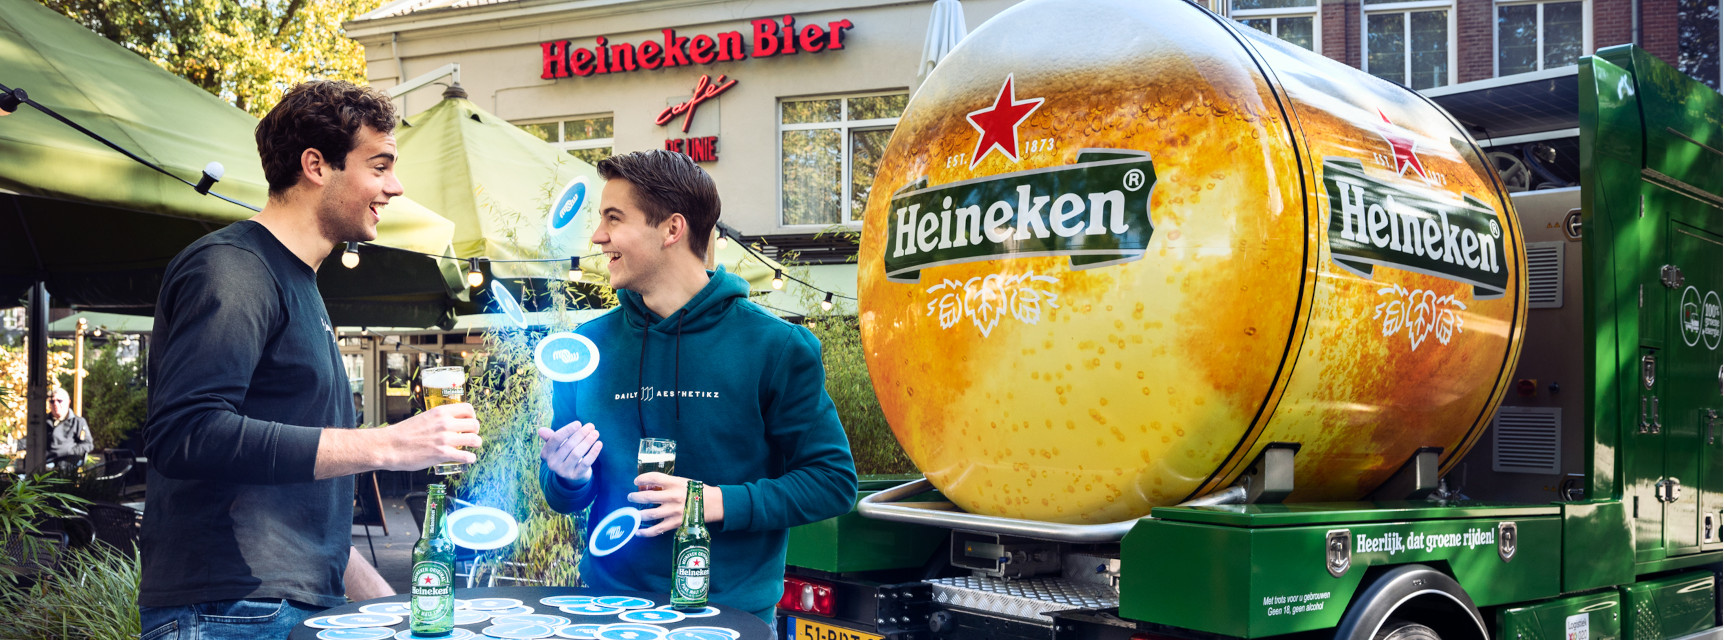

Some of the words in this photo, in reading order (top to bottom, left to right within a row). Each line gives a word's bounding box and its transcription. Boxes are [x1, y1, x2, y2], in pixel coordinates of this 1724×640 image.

[541, 29, 745, 80] Heineken
[751, 15, 854, 58] Bier
[655, 74, 738, 133] café
[686, 136, 719, 162] UNIE
[946, 151, 968, 169] EST.
[1024, 137, 1055, 154] 1873
[1373, 152, 1394, 170] EST.
[892, 184, 1130, 258] Heineken
[1335, 180, 1500, 274] Heineken
[614, 391, 638, 400] DAILY
[656, 390, 720, 399] AESHETIKZ
[1356, 532, 1405, 556] Heerlijk,
[1407, 531, 1425, 550] dat
[1426, 532, 1462, 553] groene
[1463, 528, 1495, 550] rijden!
[411, 585, 449, 596] Heineken
[1263, 597, 1274, 606] Met
[1274, 595, 1286, 604] trots
[1287, 595, 1298, 603] voor
[1303, 592, 1331, 603] gebrouwen
[1267, 606, 1282, 616] Geen
[1292, 605, 1305, 615] geen
[1305, 601, 1325, 611] alcohol
